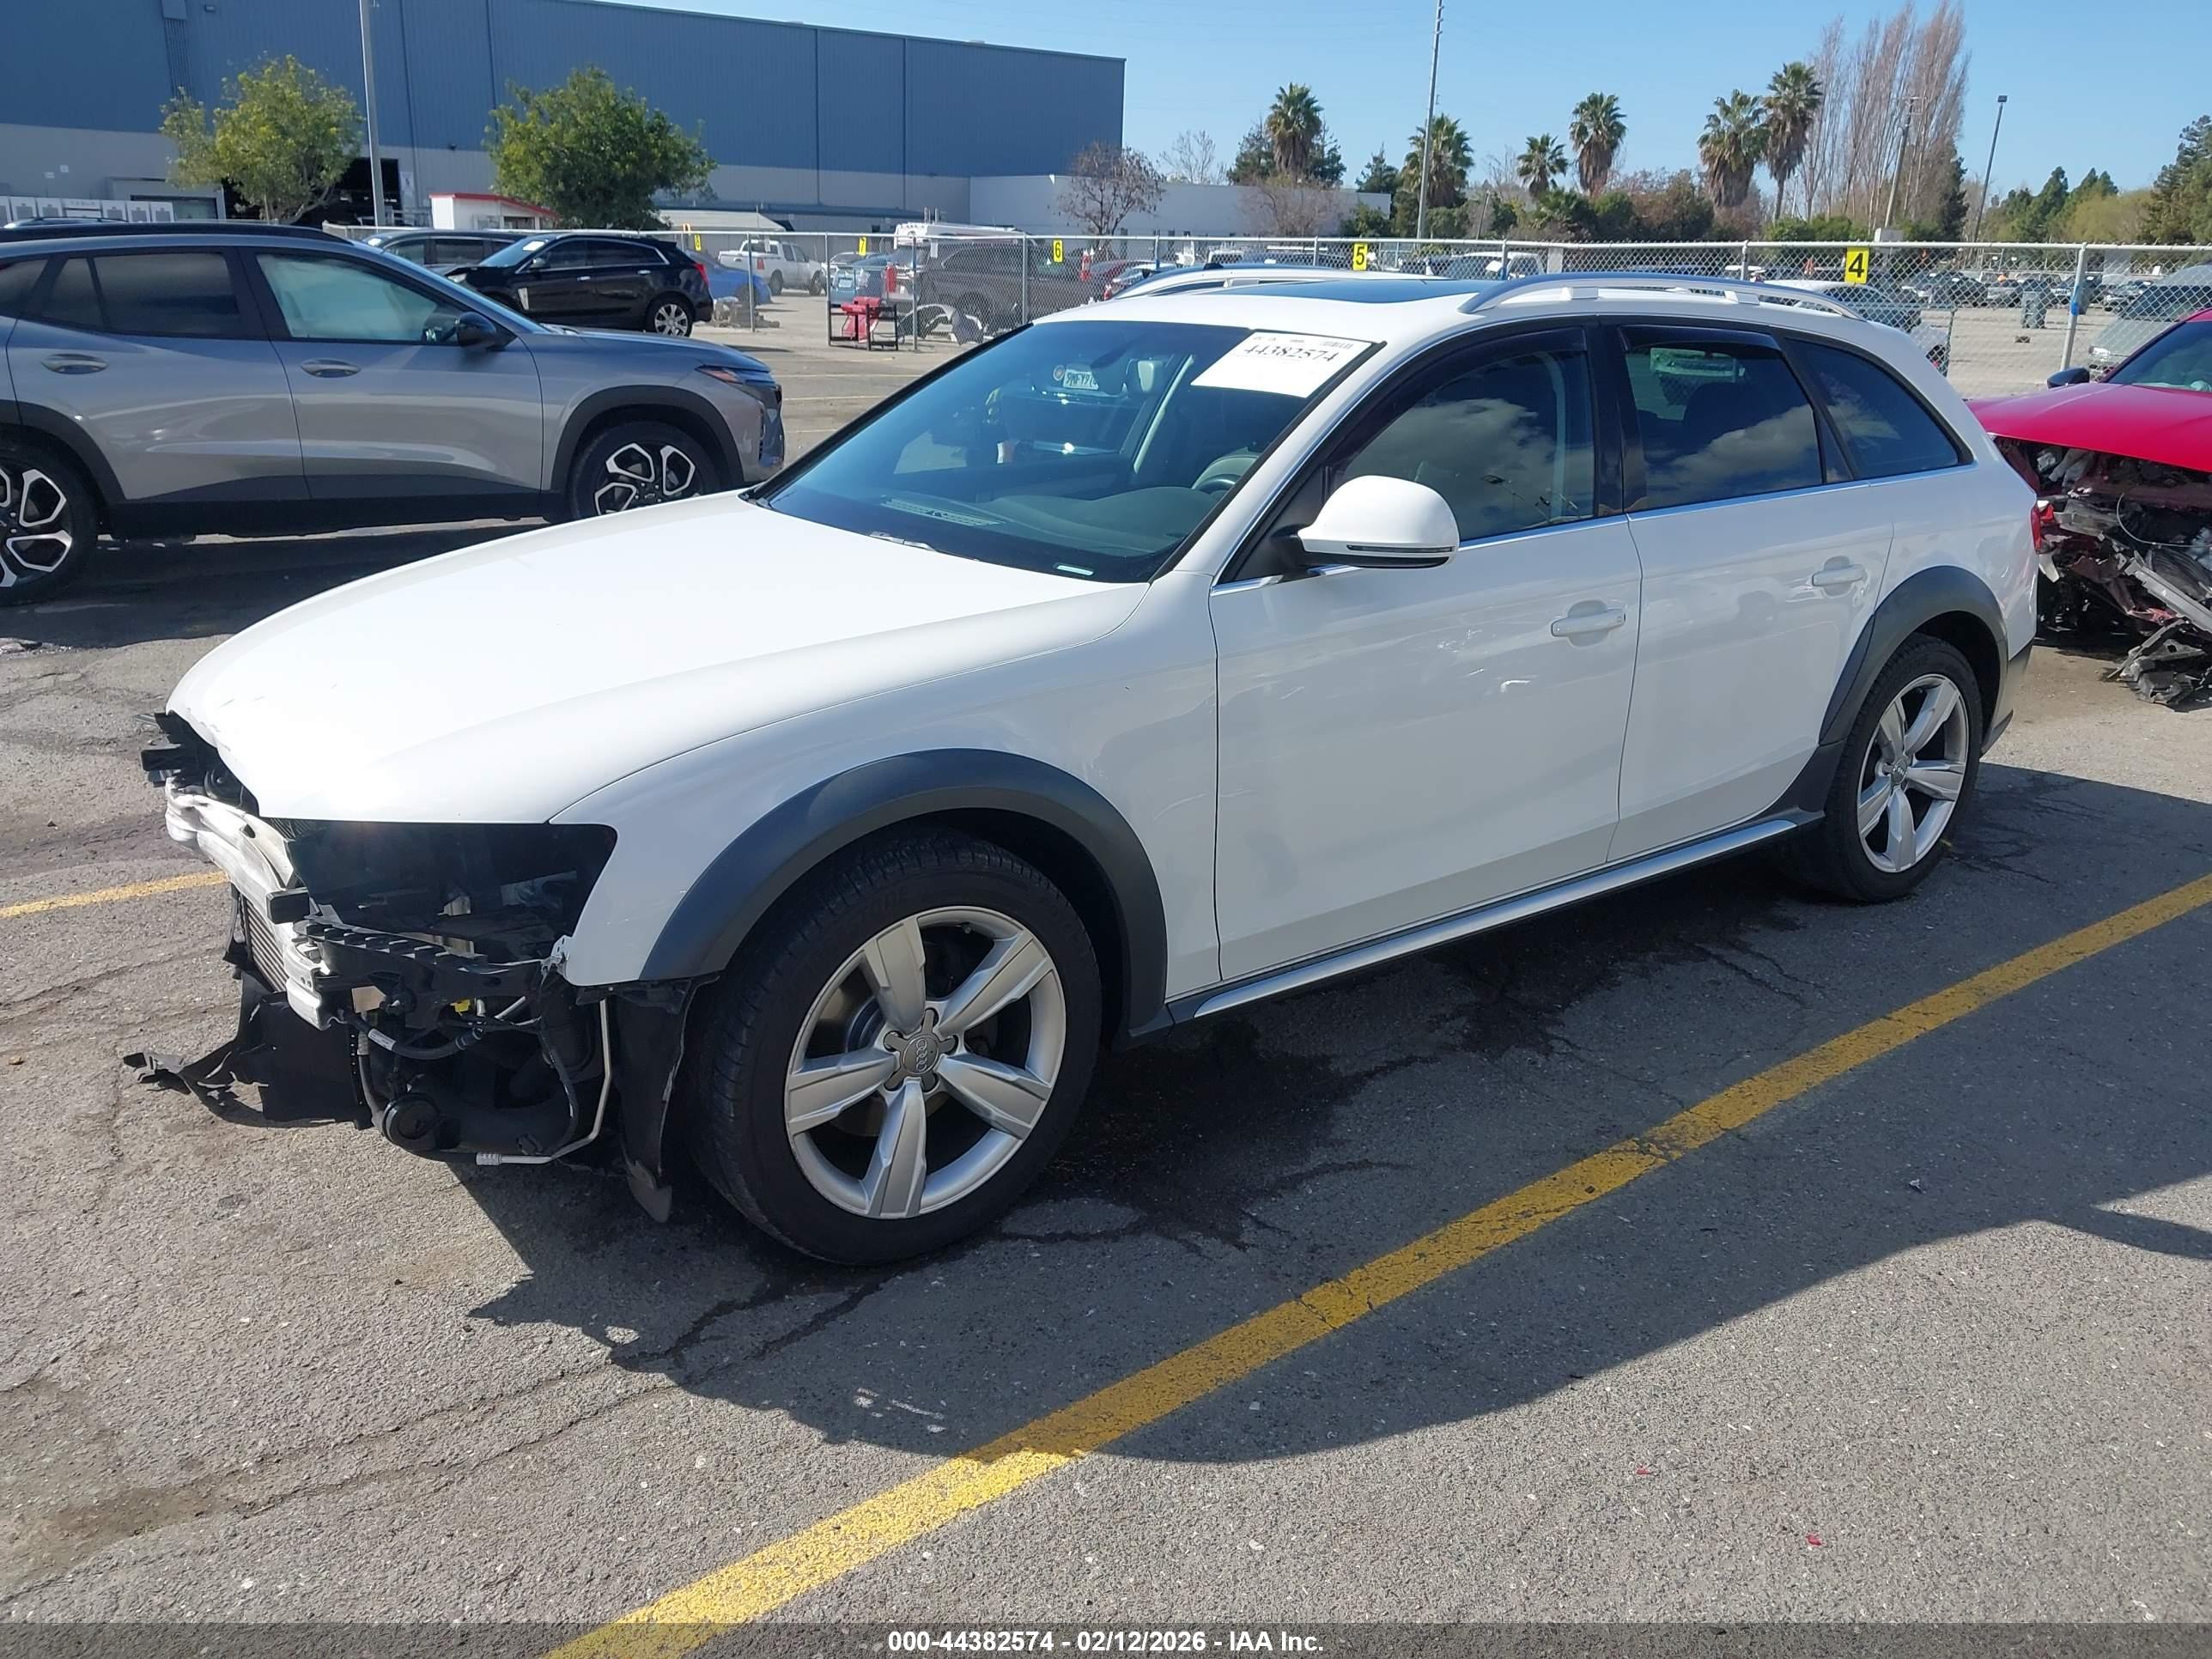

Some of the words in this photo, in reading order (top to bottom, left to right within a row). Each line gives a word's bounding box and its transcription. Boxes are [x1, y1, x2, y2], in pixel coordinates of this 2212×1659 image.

[1054, 241, 1061, 258] 6
[1355, 246, 1365, 265] 5
[1848, 252, 1865, 278] 4
